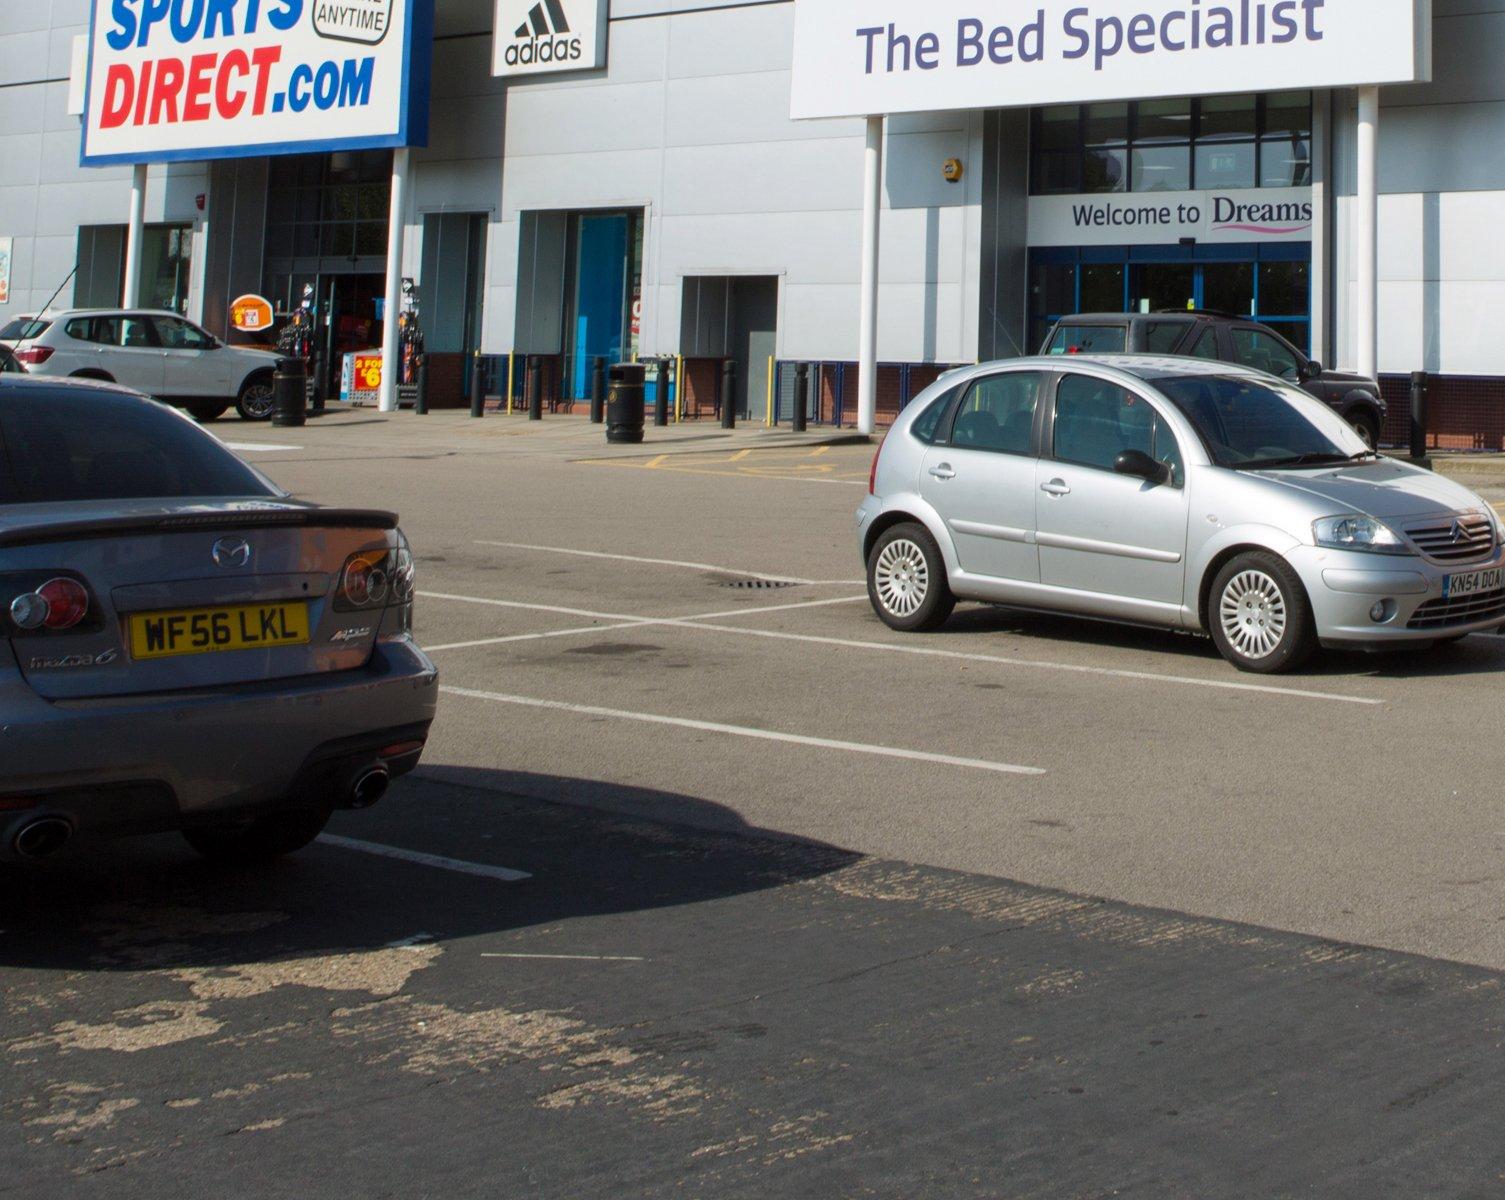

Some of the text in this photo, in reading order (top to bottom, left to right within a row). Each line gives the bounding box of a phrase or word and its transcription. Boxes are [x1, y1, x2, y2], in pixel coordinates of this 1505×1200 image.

[317, 3, 385, 31] ANYTIME
[505, 35, 582, 66] adidas
[856, 23, 940, 74] The
[955, 9, 1046, 68] Bed
[1072, 197, 1312, 226] Welcome to Dreams
[355, 359, 363, 368] 2
[360, 368, 381, 388] £6
[145, 612, 231, 652] WF56
[239, 608, 299, 642] LKL
